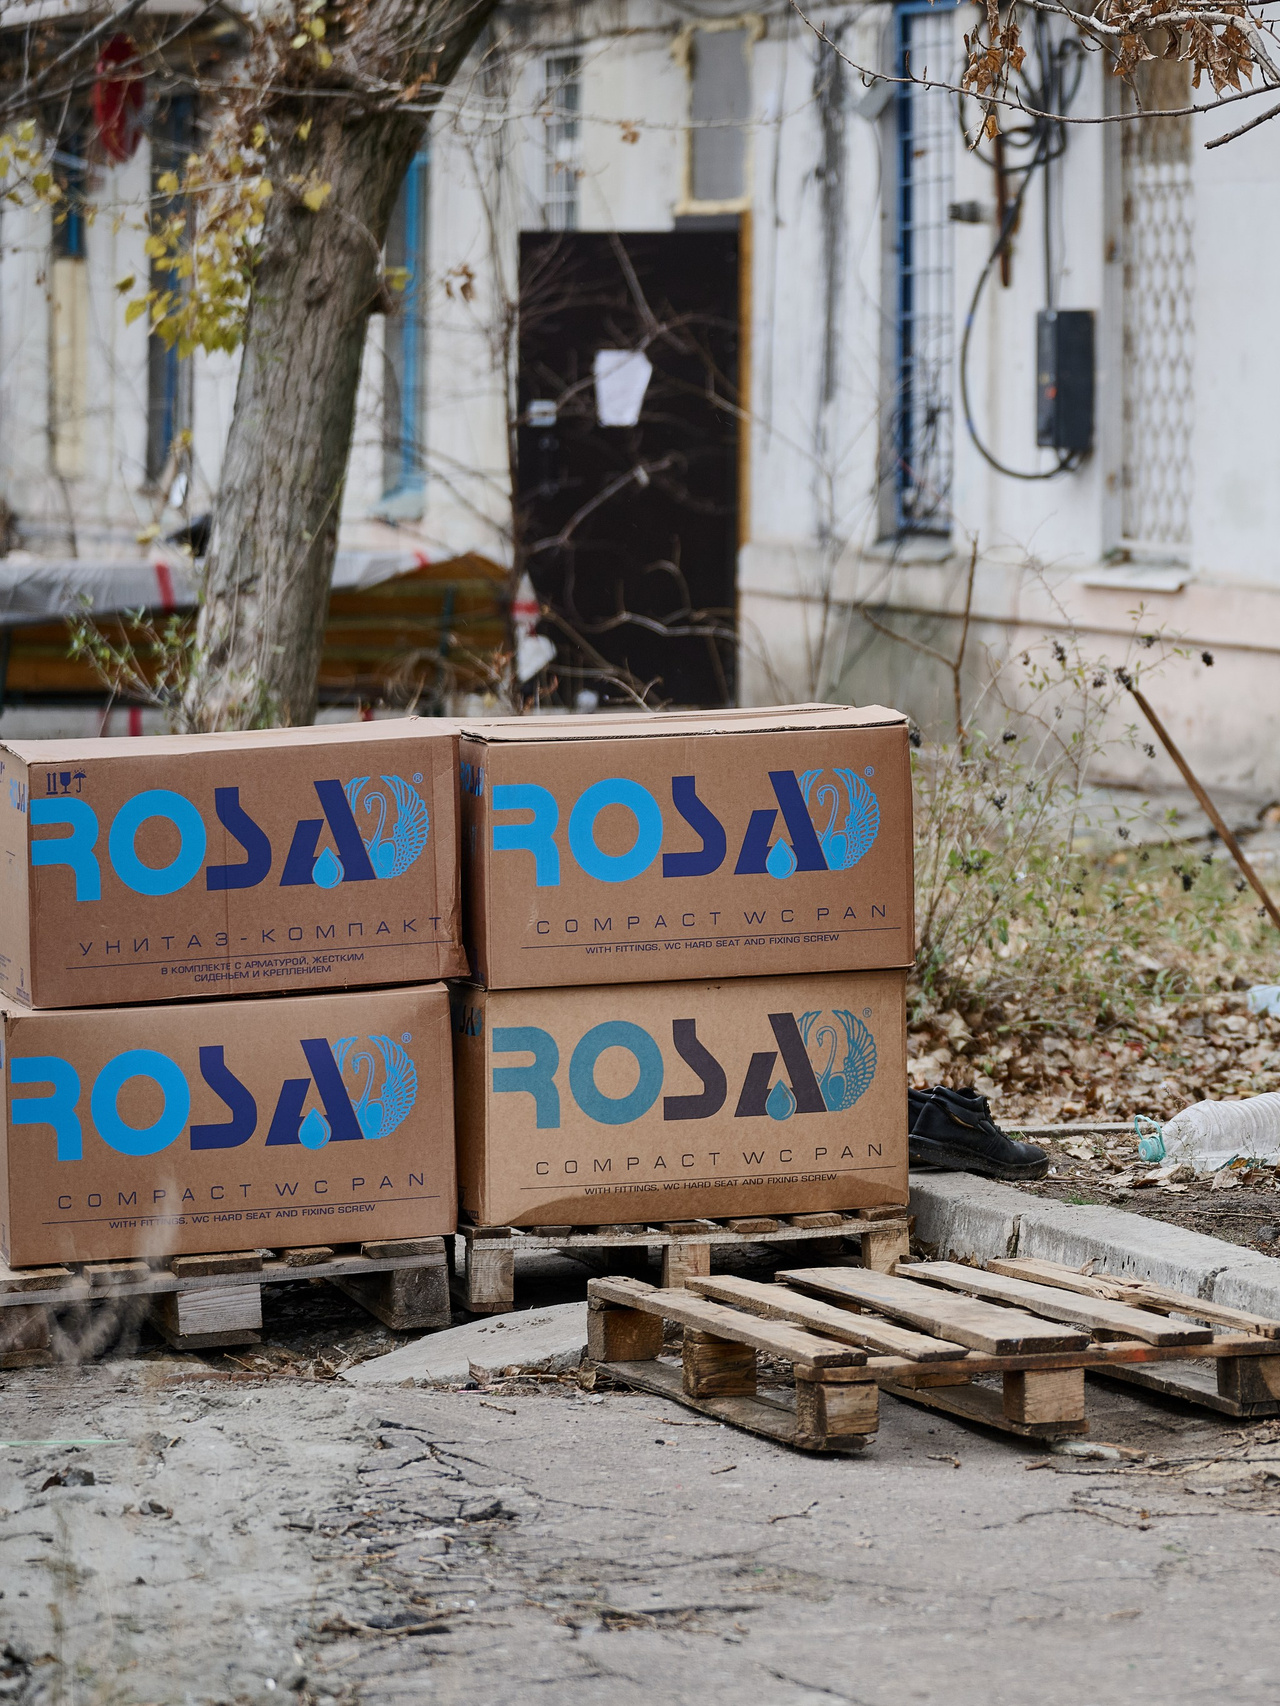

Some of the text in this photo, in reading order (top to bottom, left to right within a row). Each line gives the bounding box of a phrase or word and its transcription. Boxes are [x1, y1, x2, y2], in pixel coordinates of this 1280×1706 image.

[31, 779, 377, 902] ROSA
[492, 770, 829, 886] ROSA
[536, 904, 886, 935] COMPACT WC PAN
[79, 916, 441, 957] УНИТАЗ-КОМПАКТ
[585, 933, 840, 954] WITH FITTINGS, WC HARD SEAT AND FIXING SCREW
[161, 952, 365, 975] В КОМПЛЕКТЕ С АРМАТУРОЙ, ЖЕСТКИМ
[194, 971, 250, 983] СИДЕНЬЕМ
[262, 964, 332, 977] КРЕПЛЕНИЕМ
[492, 1013, 828, 1130] ROSA
[11, 1038, 364, 1162] ROSA
[536, 1142, 883, 1175] COMPACT WC PAN
[57, 1172, 425, 1210] COMPACT WC PAN
[584, 1173, 837, 1195] WITH FITTINGS, WC HARD SEAT AND FIXING SCREW
[109, 1220, 137, 1229] WITH
[192, 1215, 210, 1223] WC
[213, 1213, 242, 1222] HARD
[246, 1211, 271, 1220] SEAT
[275, 1209, 298, 1218] AND
[301, 1207, 334, 1216] FIXING
[337, 1203, 376, 1213] SCREW
